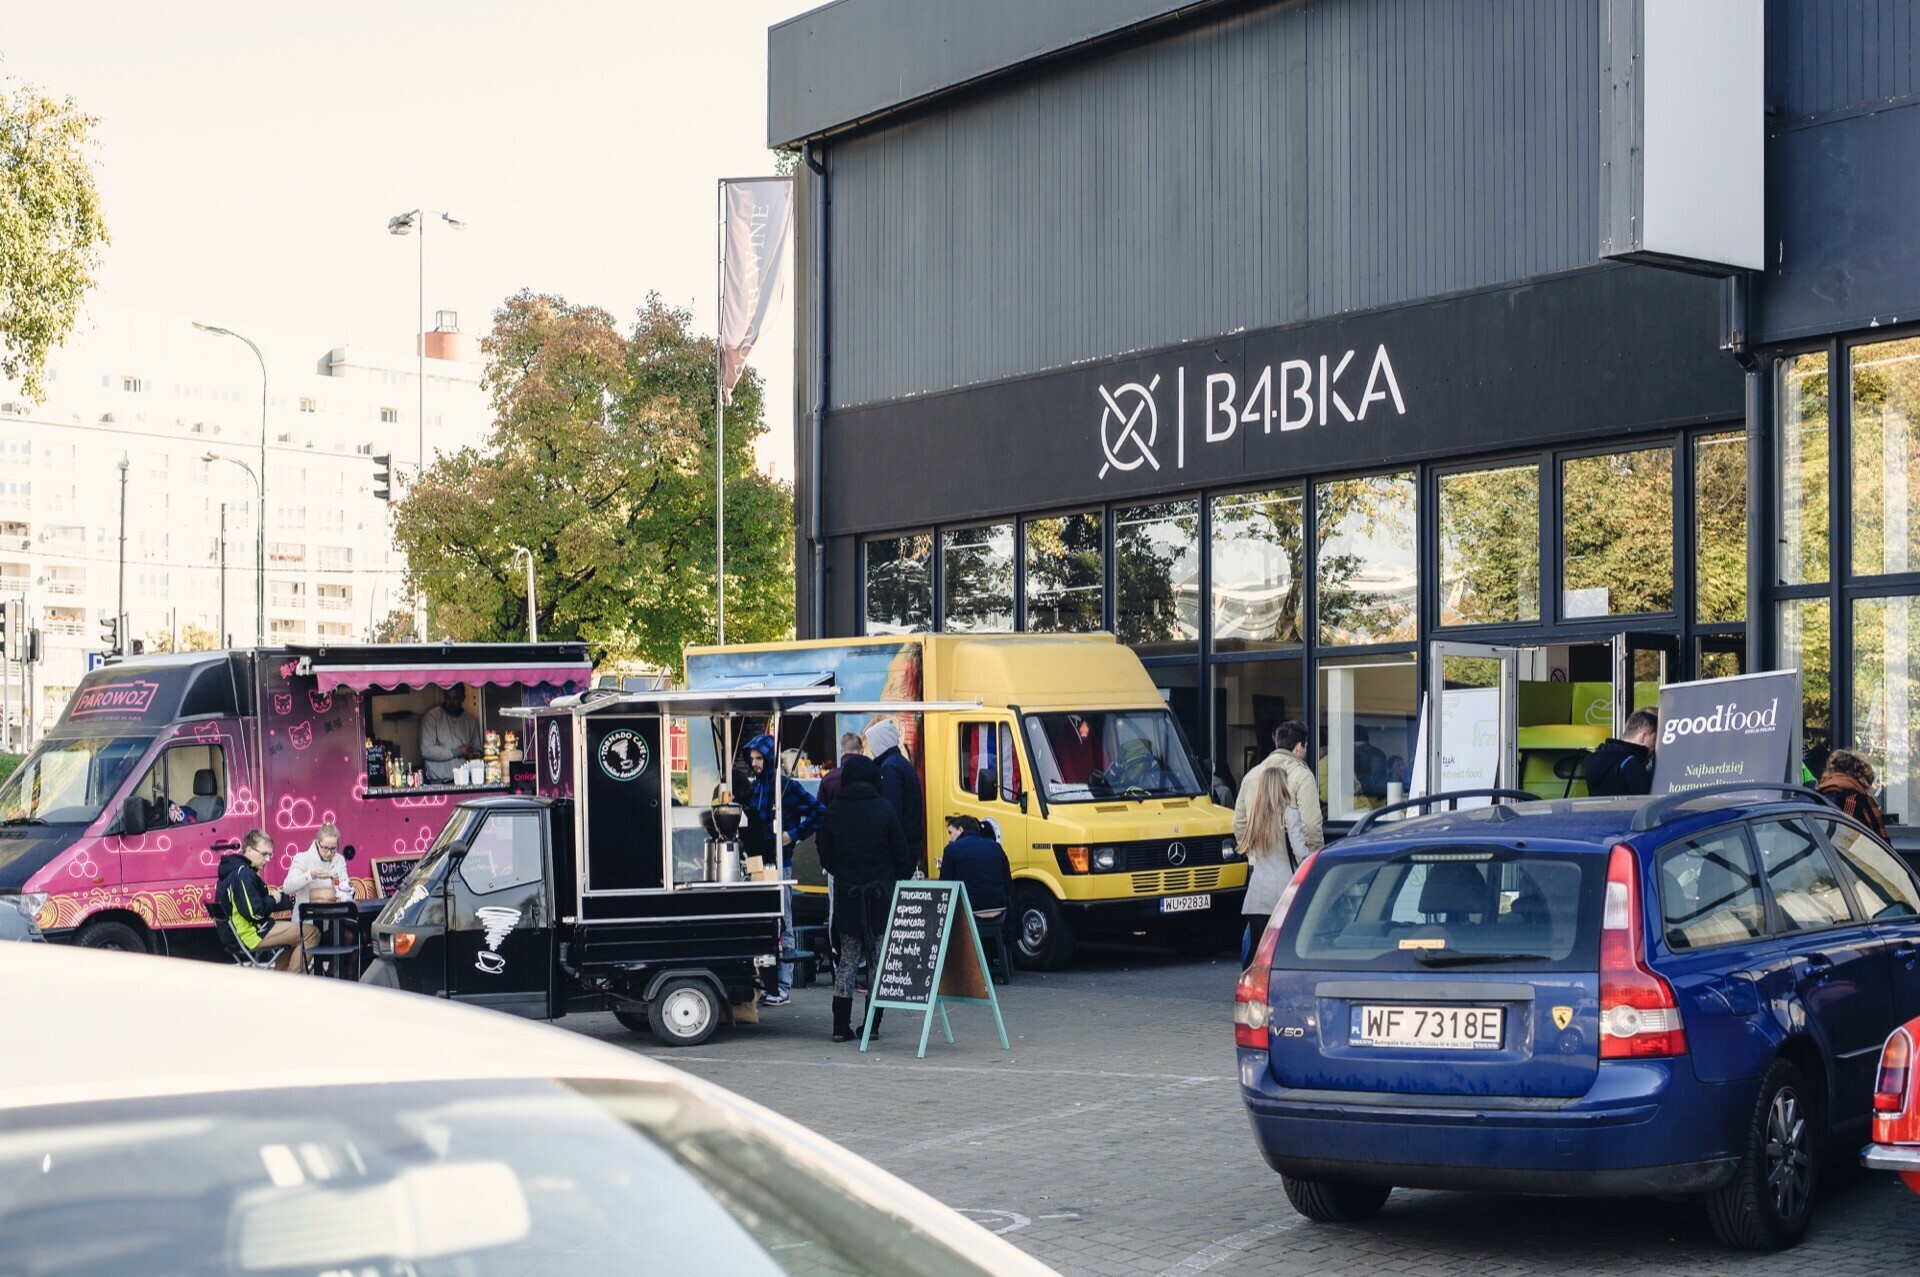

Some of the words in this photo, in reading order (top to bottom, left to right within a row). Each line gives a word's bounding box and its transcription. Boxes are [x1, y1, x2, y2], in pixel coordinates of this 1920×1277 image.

[78, 690, 150, 710] PAROWOZ
[1661, 698, 1779, 745] goodfood
[601, 731, 632, 756] TORNADO
[1684, 761, 1744, 778] Najbardziej
[1166, 899, 1179, 910] WU
[1182, 896, 1210, 909] 9283A
[896, 904, 923, 918] espresso
[893, 916, 926, 928] americano
[891, 927, 926, 944] cappuccino
[888, 942, 902, 960] flat
[903, 942, 921, 956] white
[885, 958, 903, 971] latte
[924, 975, 931, 987] 6
[1351, 1026, 1361, 1034] PL
[1367, 1009, 1404, 1037] WF
[1413, 1010, 1498, 1040] 7318E
[1273, 1027, 1305, 1039] V50
